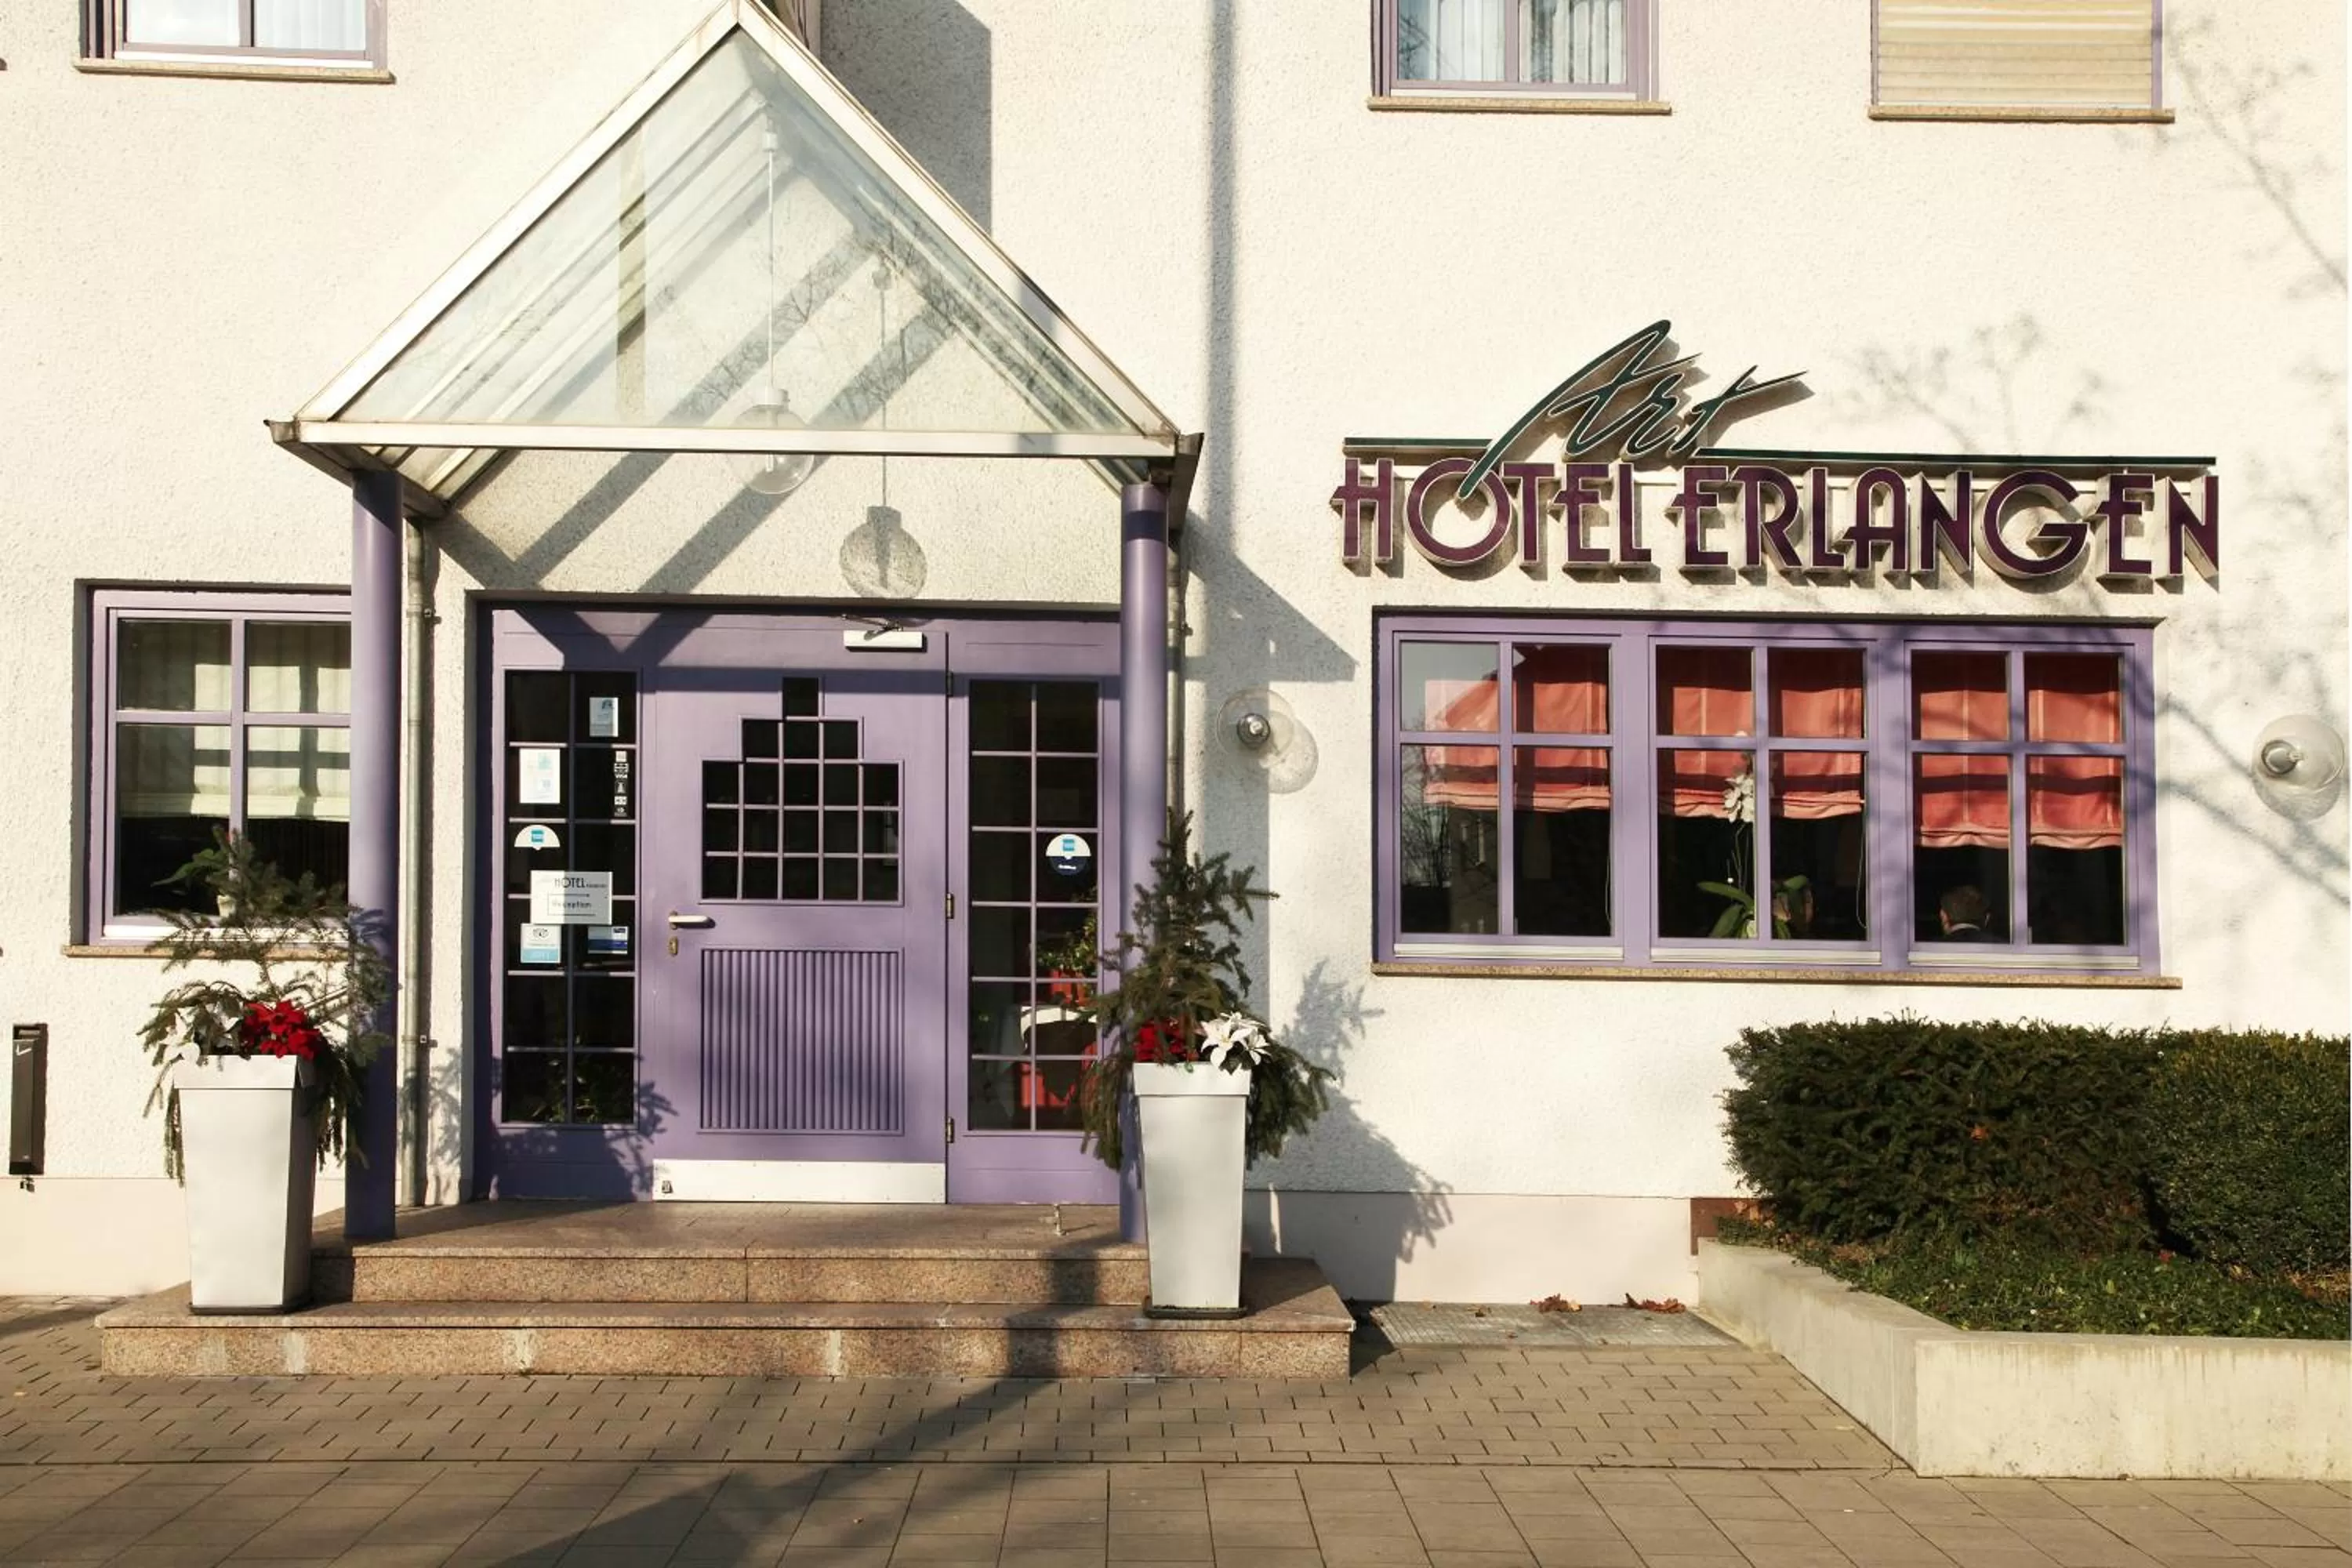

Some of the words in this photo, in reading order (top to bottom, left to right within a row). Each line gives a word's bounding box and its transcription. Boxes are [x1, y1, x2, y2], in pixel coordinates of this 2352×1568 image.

[1457, 318, 1809, 500] Art
[1330, 457, 1653, 567] HOTEL
[1671, 464, 2220, 579] ERLANGEN
[554, 877, 586, 888] HOTEL
